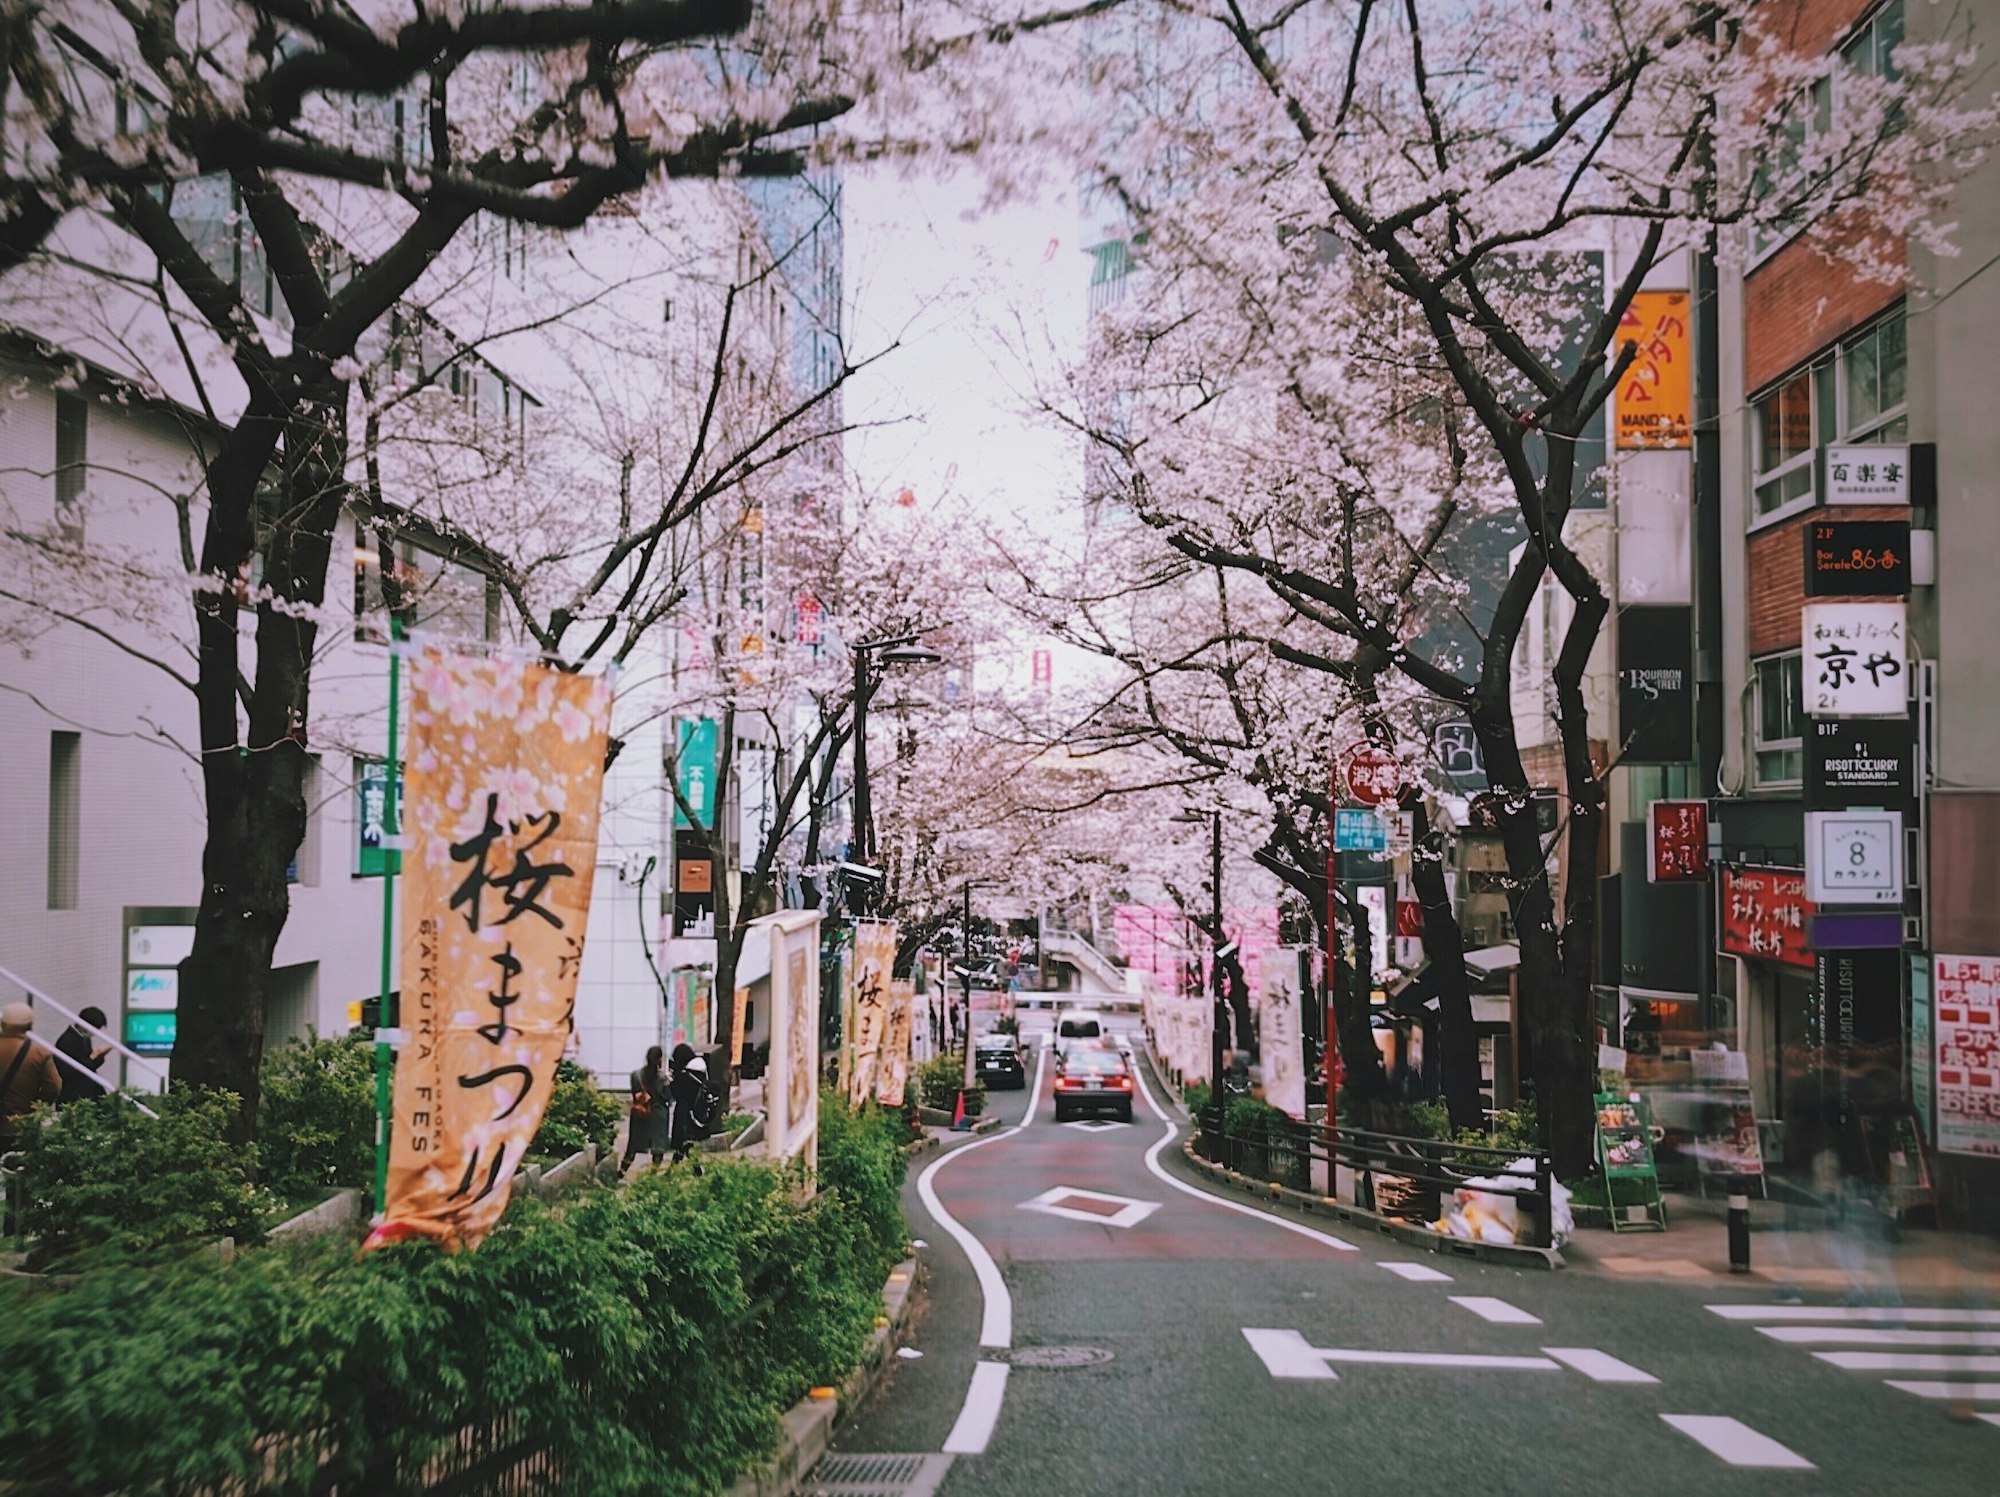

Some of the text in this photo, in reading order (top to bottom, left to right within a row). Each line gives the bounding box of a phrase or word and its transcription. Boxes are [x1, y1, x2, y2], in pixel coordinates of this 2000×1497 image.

[1621, 413, 1686, 427] MANDLA
[1816, 528, 1834, 539] 2F
[1814, 643, 1901, 690] 京や
[1630, 669, 1682, 689] BOURBON
[1817, 723, 1839, 736] B1F
[1836, 771, 1888, 780] STANDARD
[1850, 841, 1865, 866] 8
[449, 793, 575, 1203] 桜まつり
[411, 918, 433, 1153] SAKURA FES
